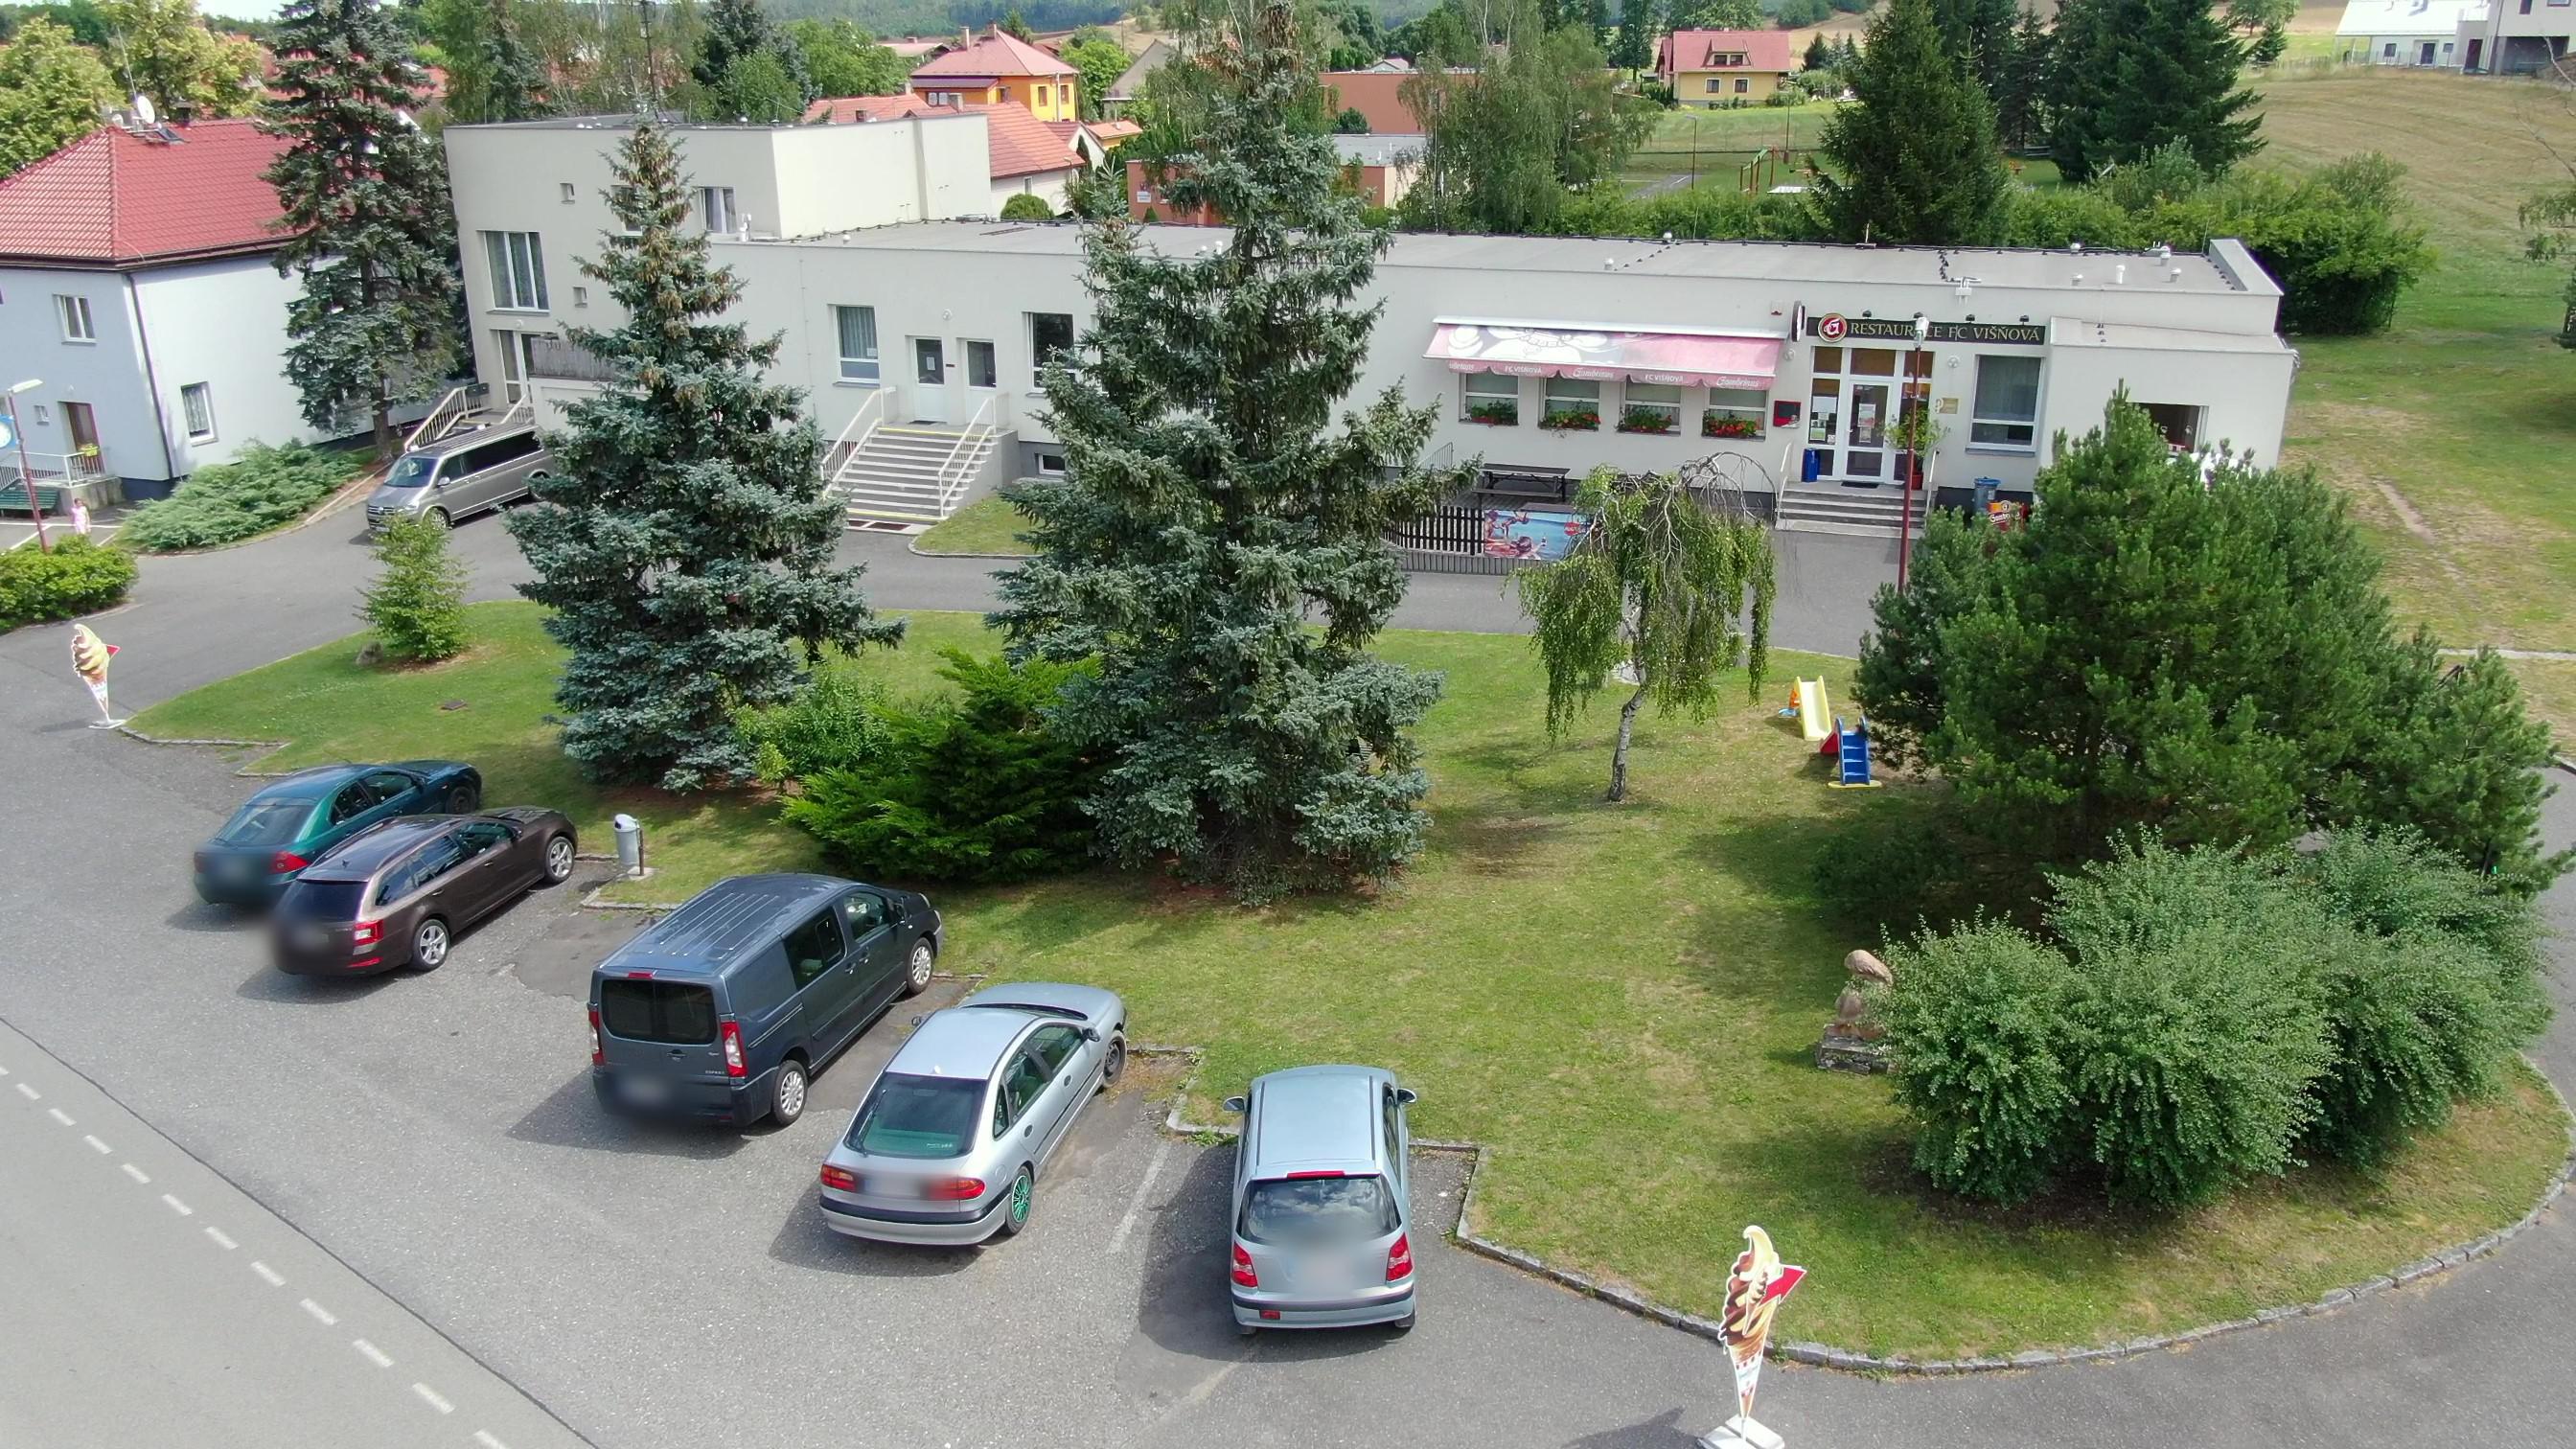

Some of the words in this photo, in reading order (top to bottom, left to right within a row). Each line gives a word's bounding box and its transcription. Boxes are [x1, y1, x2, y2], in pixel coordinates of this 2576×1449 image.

[1851, 322, 1942, 337] RESTAURCE
[1948, 326, 1967, 339] FC
[1973, 325, 2040, 341] VIŠŇOVÁ
